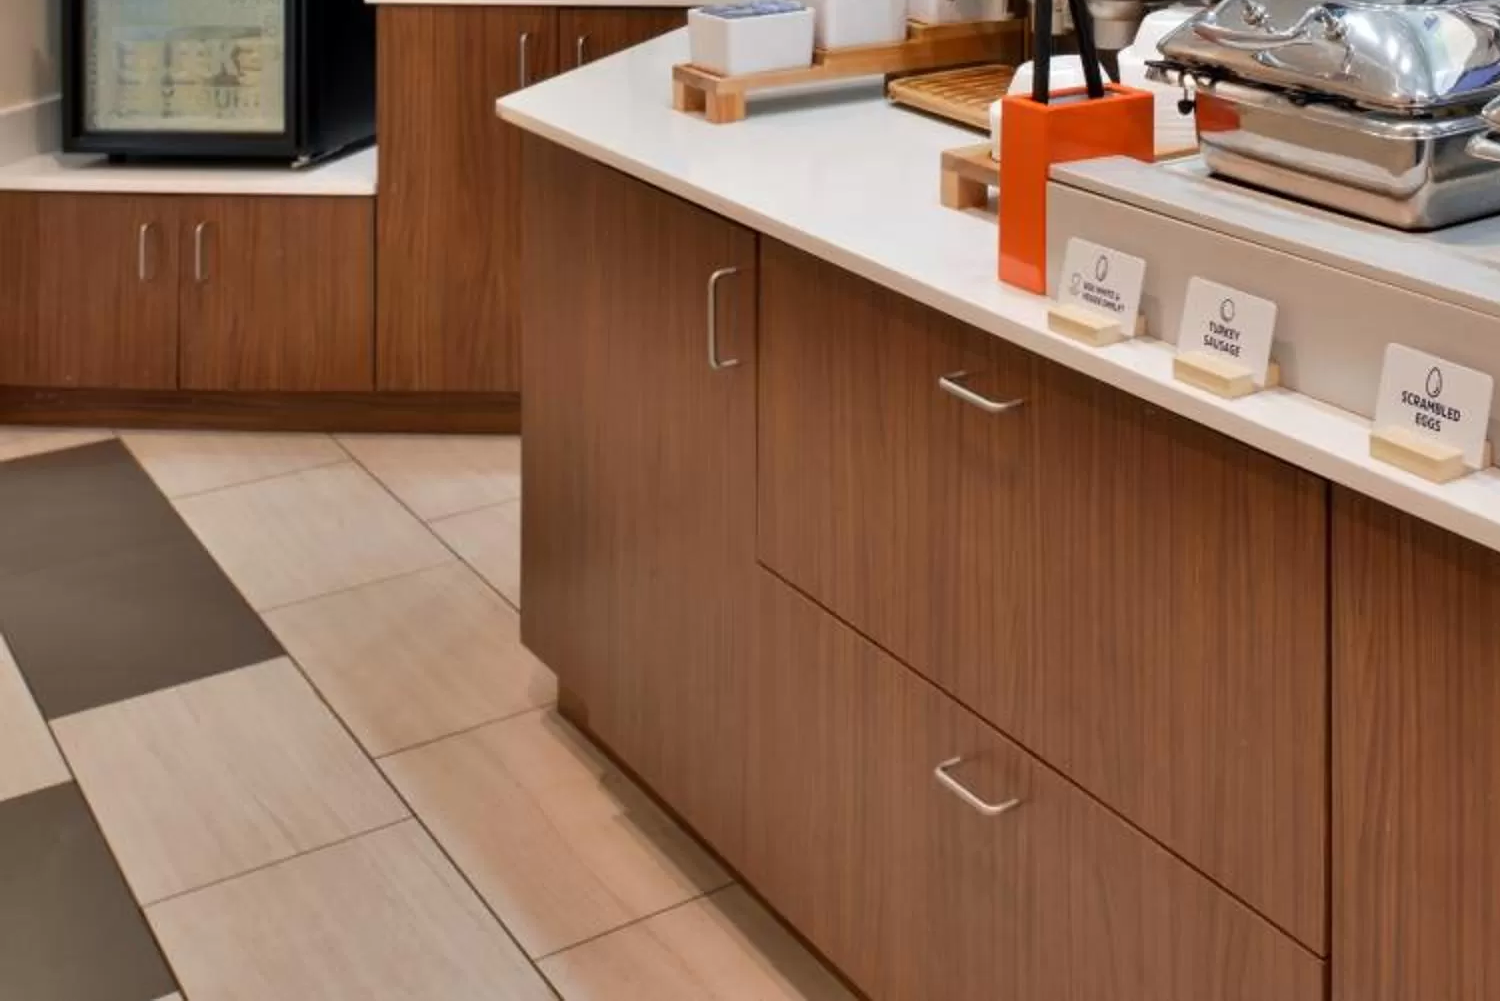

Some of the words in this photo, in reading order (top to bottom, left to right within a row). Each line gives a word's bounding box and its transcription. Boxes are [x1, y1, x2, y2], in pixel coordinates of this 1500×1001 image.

[1208, 320, 1241, 340] TURKEY
[1203, 334, 1241, 357] SAUSAGE
[1401, 390, 1461, 422] SCRAMBLED
[1415, 412, 1441, 432] EGGS
